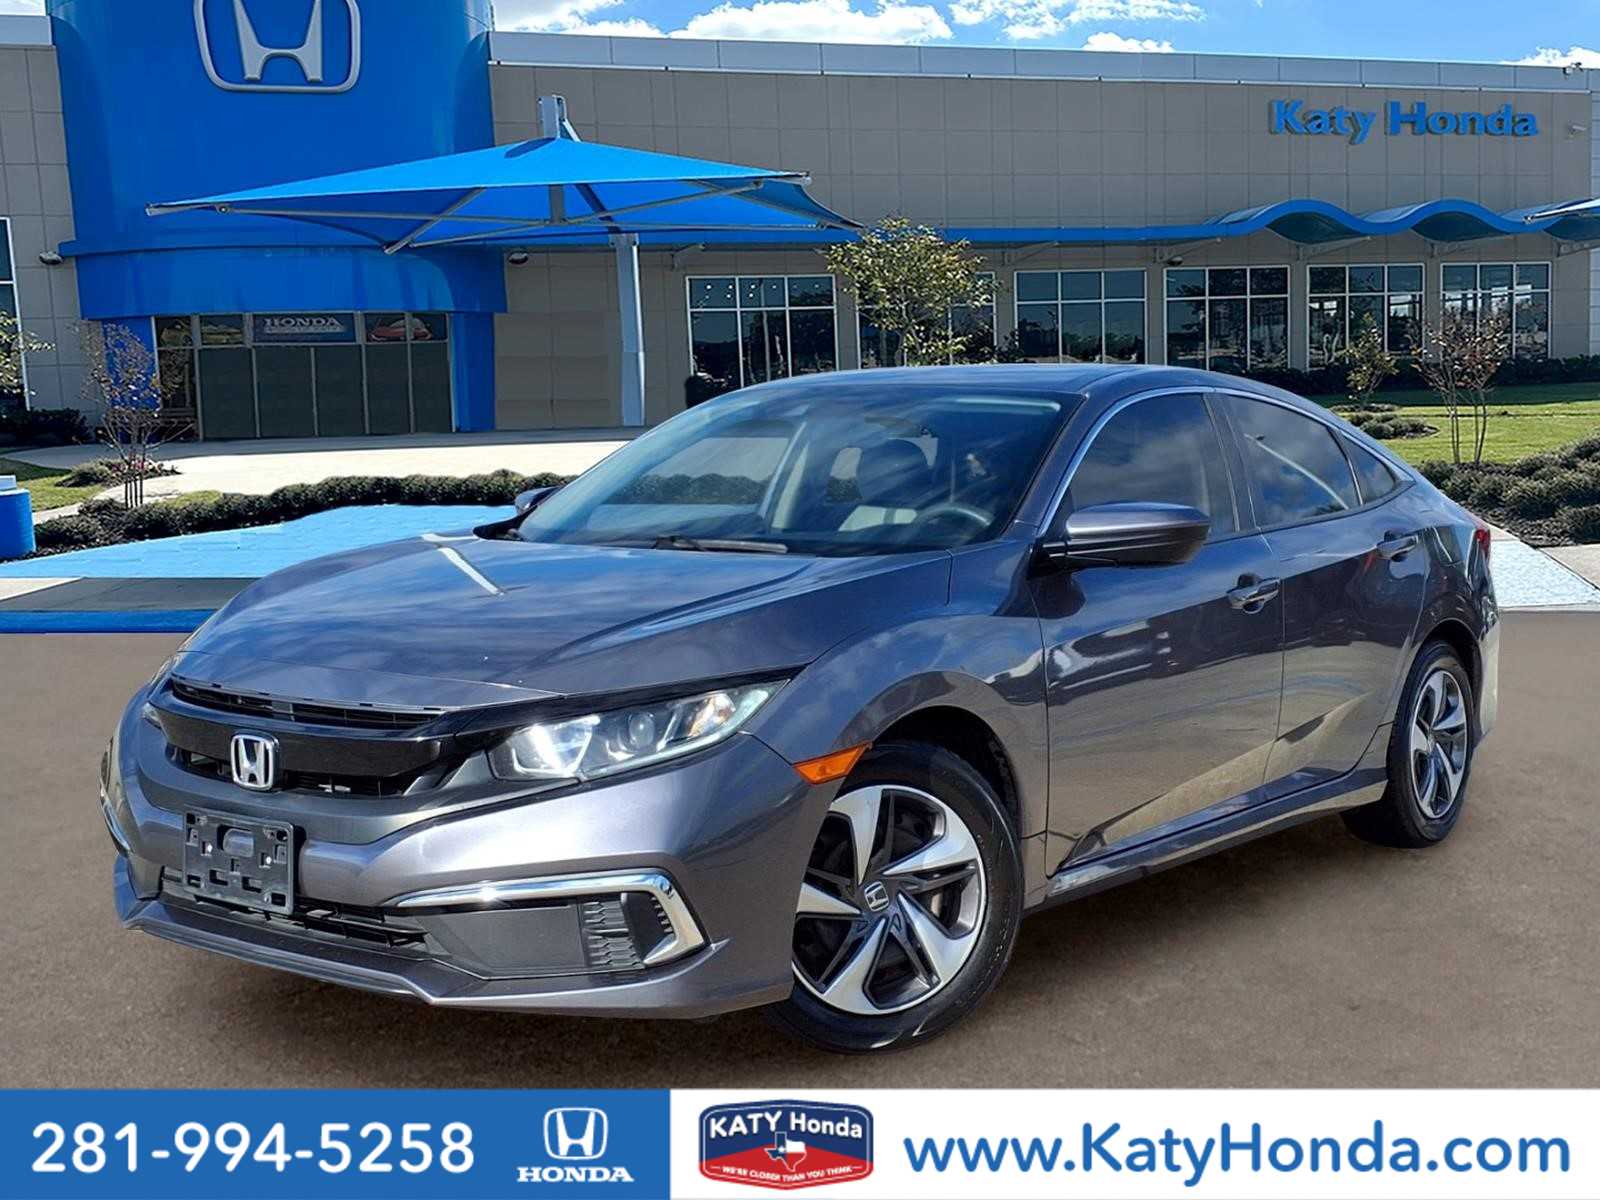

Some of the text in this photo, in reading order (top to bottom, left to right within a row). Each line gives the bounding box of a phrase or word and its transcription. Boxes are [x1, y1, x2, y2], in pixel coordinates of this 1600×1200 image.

[1269, 99, 1539, 145] Katy Honda
[264, 317, 344, 327] HONDA
